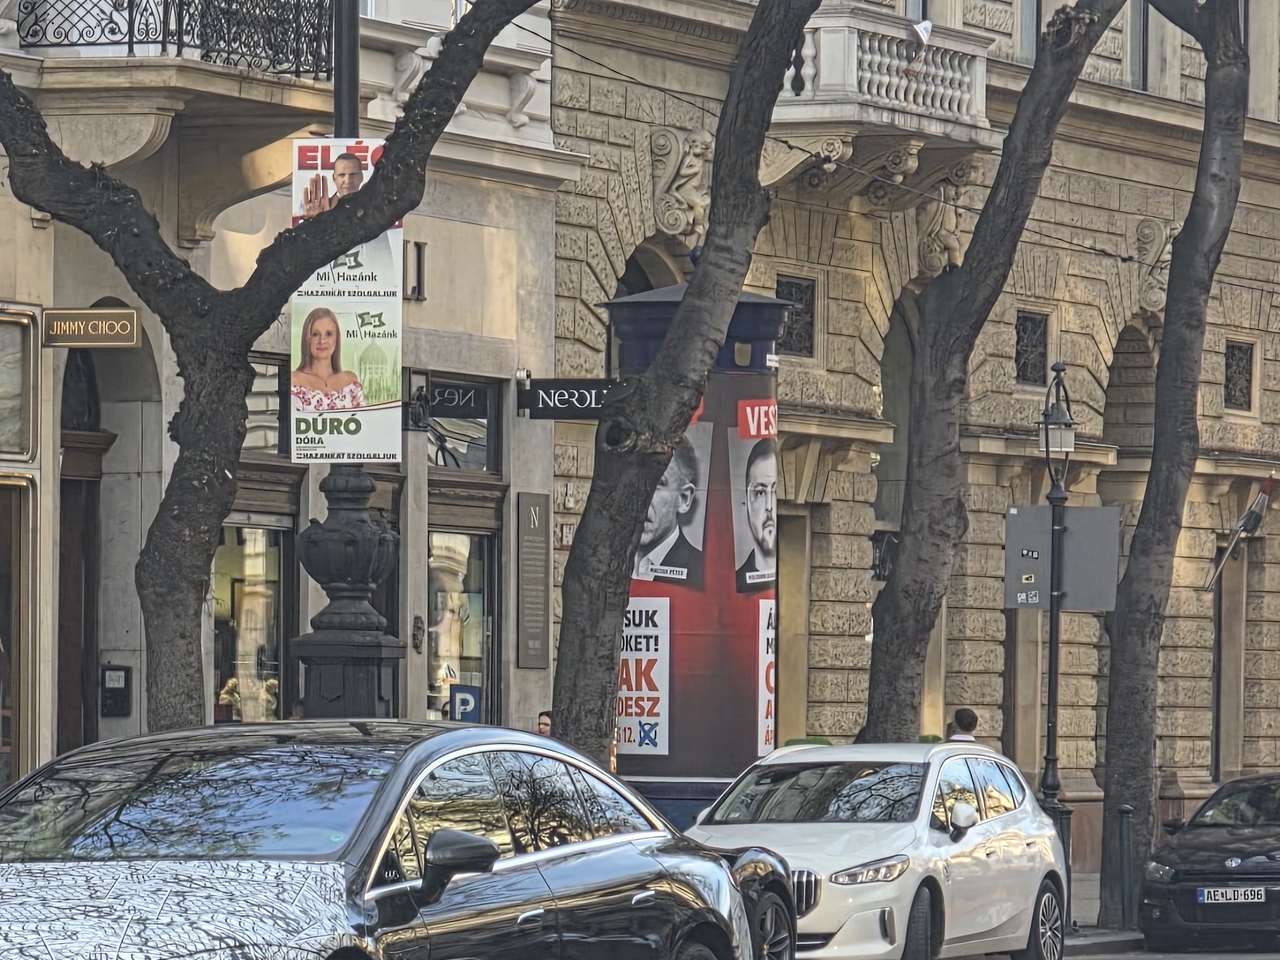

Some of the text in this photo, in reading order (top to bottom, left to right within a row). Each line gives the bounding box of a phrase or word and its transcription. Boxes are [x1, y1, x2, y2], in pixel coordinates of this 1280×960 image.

[49, 320, 131, 335] JIMMY CHOO
[346, 330, 358, 339] Mi
[455, 693, 475, 720] P
[623, 727, 636, 743] 12.
[1206, 890, 1220, 901] AE
